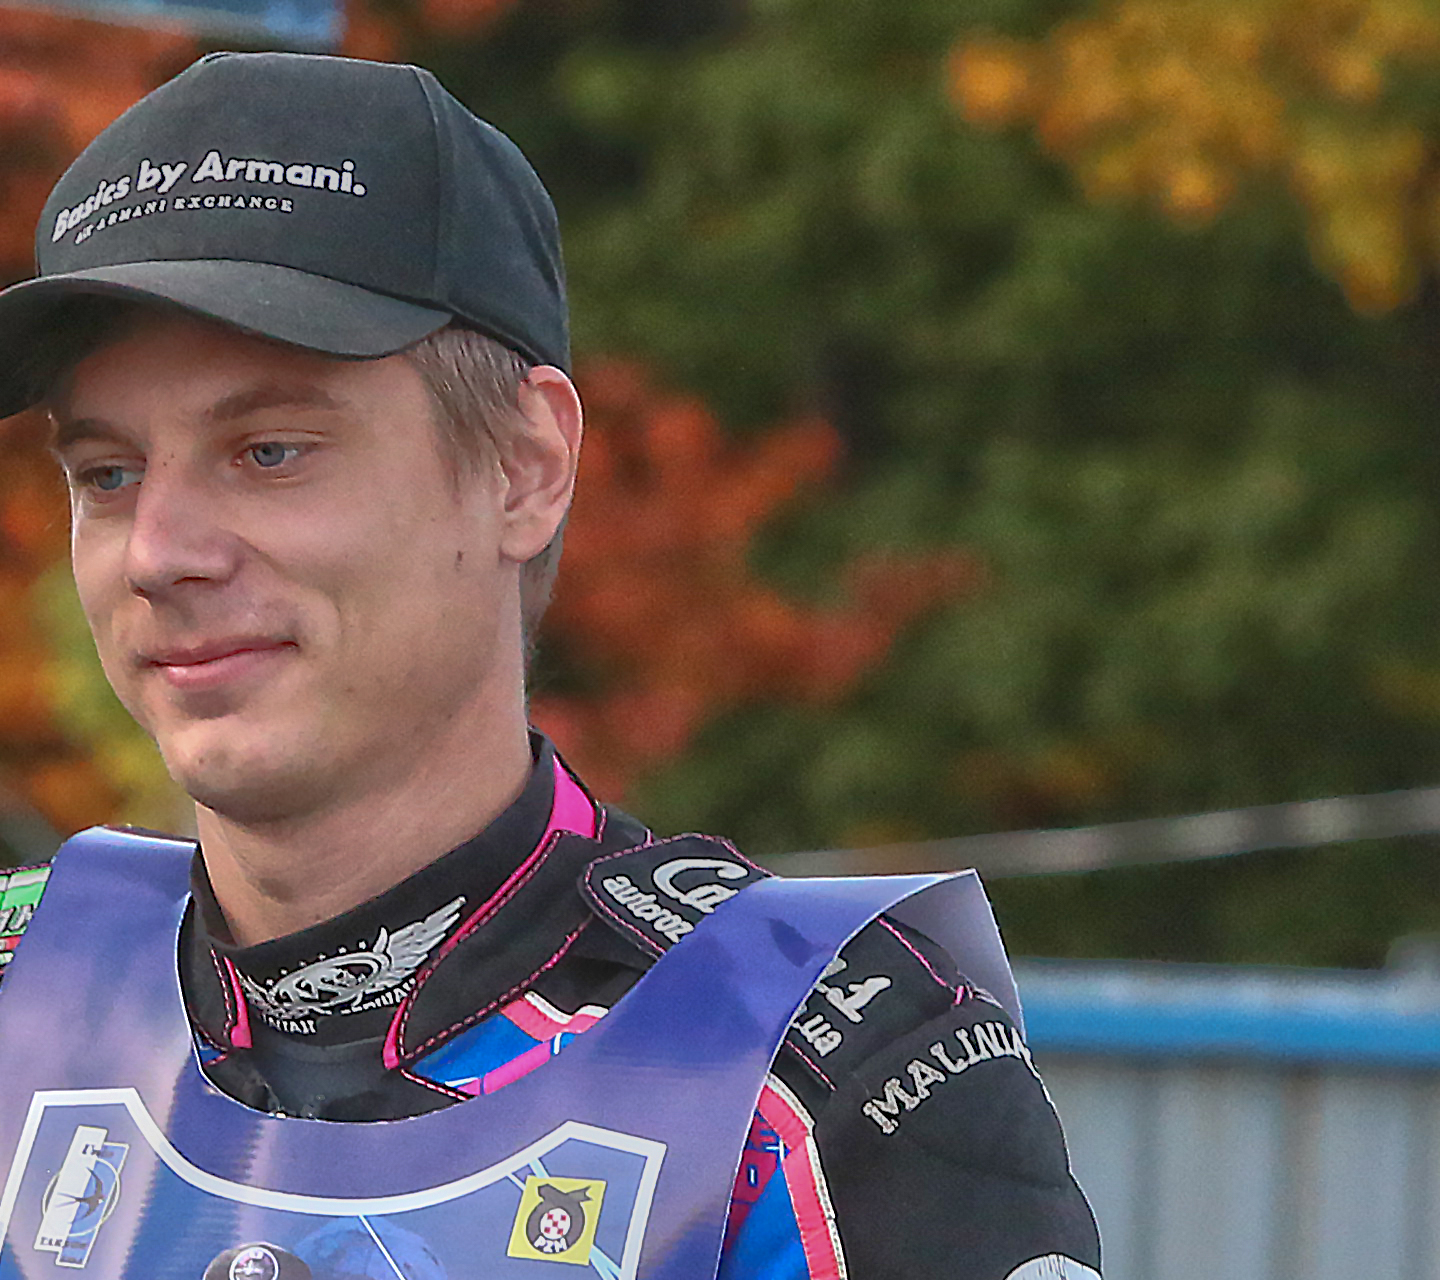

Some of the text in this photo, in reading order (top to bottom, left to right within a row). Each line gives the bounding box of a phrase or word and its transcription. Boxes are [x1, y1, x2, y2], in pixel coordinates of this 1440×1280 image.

[52, 175, 131, 242] Basics
[136, 158, 187, 194] by
[96, 199, 167, 230] ARMANI
[174, 196, 294, 213] EXCHANGE
